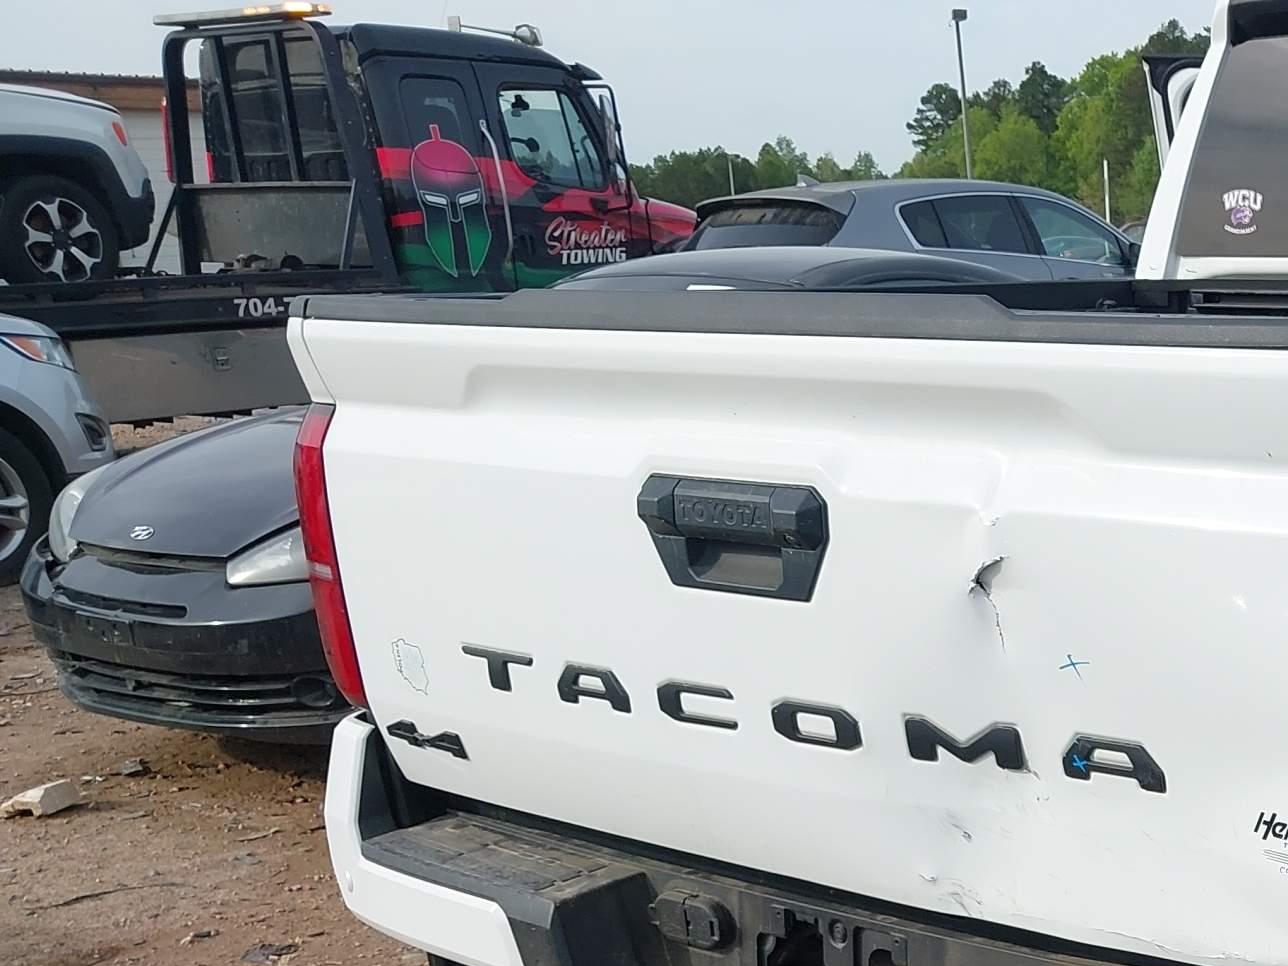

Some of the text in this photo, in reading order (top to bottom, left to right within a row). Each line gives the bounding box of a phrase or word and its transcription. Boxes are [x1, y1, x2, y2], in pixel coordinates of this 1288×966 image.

[1223, 189, 1262, 210] WCU
[545, 216, 627, 255] Streater
[560, 247, 626, 265] TOWING
[680, 501, 768, 529] TOYOTA
[461, 642, 1167, 794] TACOMA
